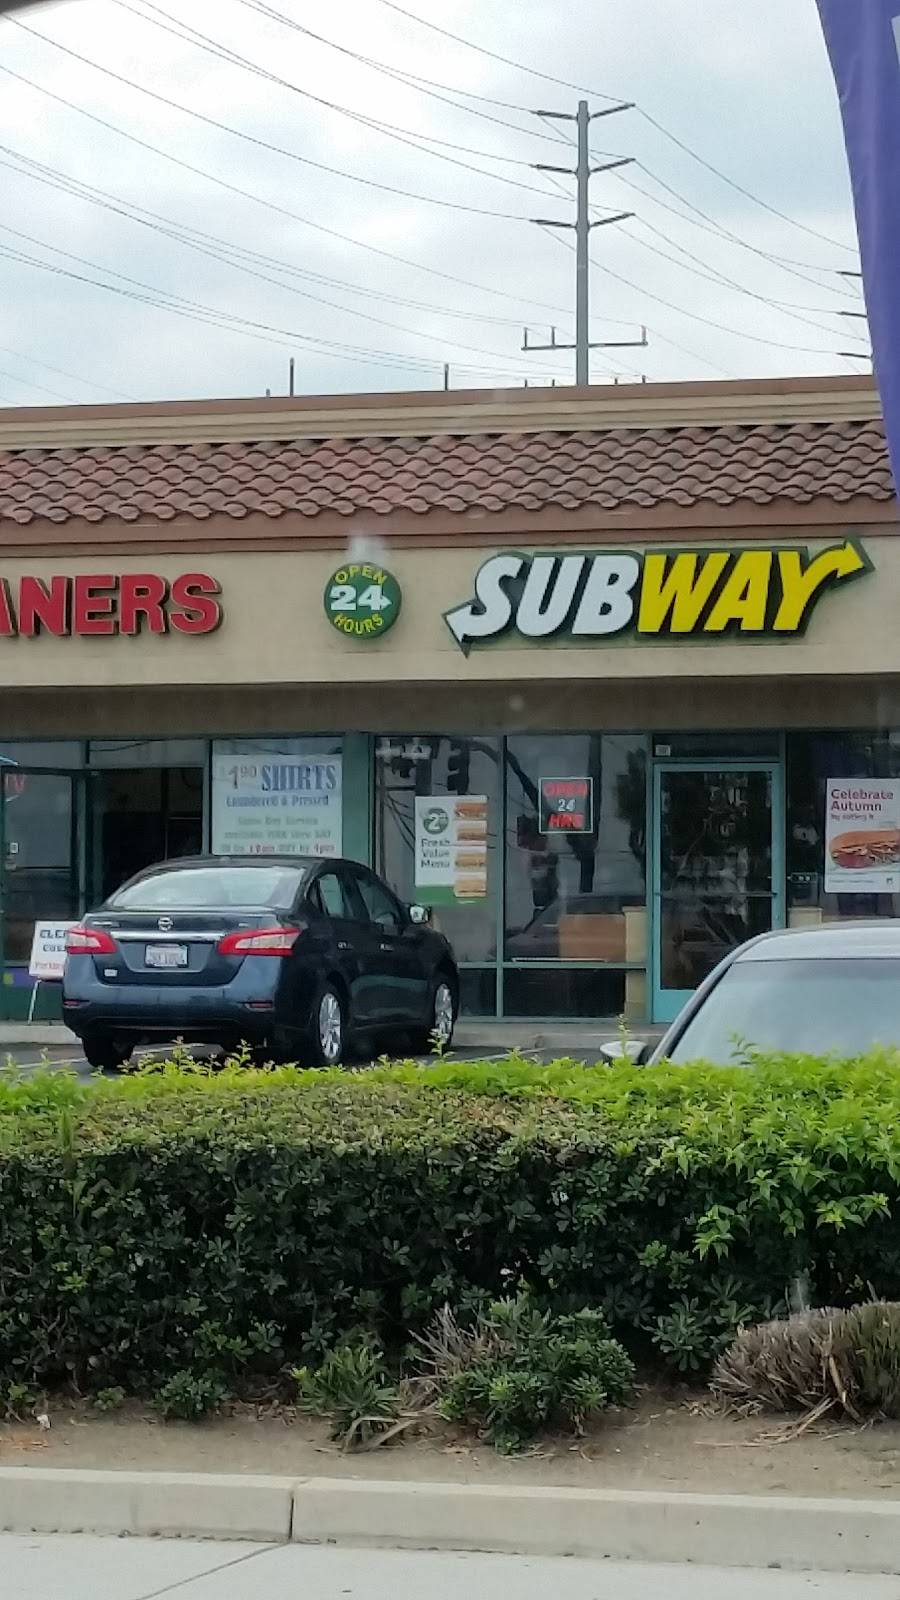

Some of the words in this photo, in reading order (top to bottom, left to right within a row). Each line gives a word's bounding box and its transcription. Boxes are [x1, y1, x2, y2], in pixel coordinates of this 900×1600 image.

[335, 565, 387, 584] OPEN
[329, 584, 391, 611] 24
[446, 542, 865, 643] SUBWAY
[334, 613, 383, 635] HOURS
[261, 764, 337, 791] SHIRTS
[831, 788, 894, 800] Celebrate
[558, 798, 576, 812] 24
[831, 800, 882, 811] Autumn
[421, 859, 450, 868] Menu
